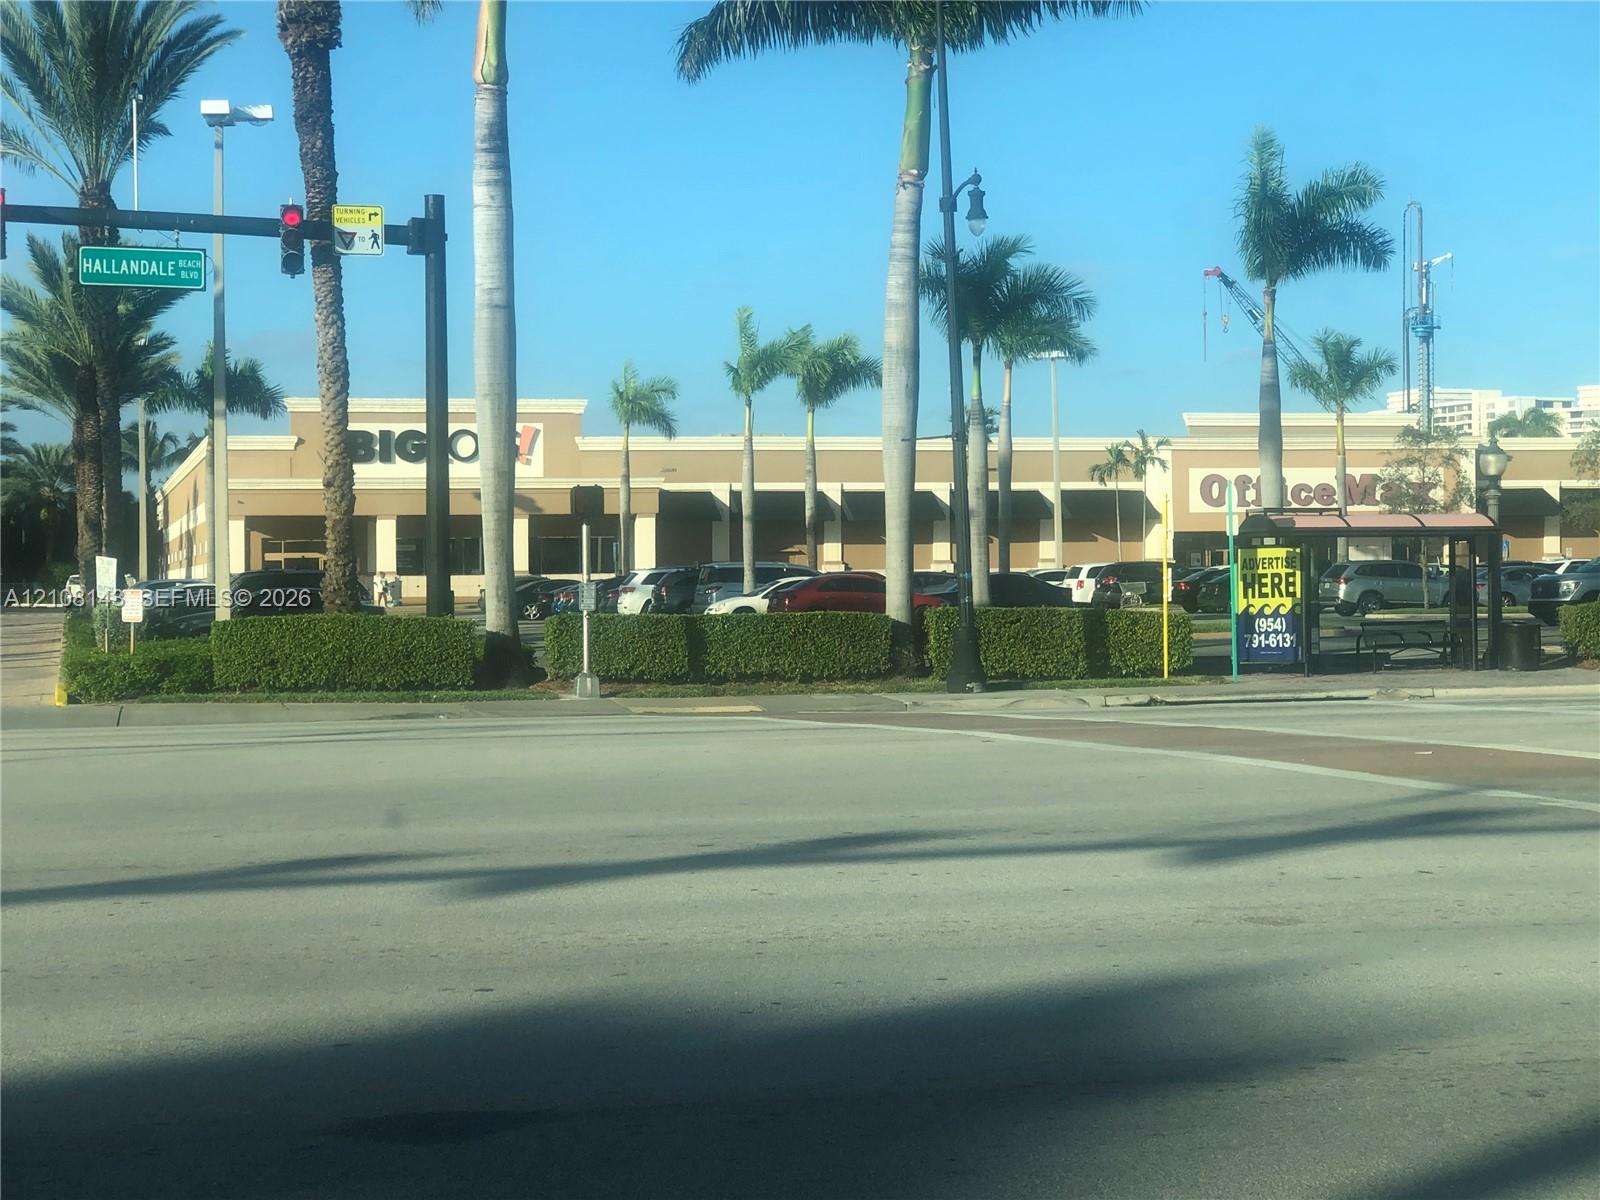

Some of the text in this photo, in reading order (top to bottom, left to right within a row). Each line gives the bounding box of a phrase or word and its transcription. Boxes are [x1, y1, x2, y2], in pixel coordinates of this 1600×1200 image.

[83, 258, 176, 276] HALLANDALE
[178, 259, 201, 269] BEACH
[180, 270, 199, 279] BLVD
[346, 429, 428, 463] BIG
[1242, 556, 1297, 570] ADVERTISE
[1242, 572, 1297, 599] HERE
[1255, 618, 1286, 632] (954)
